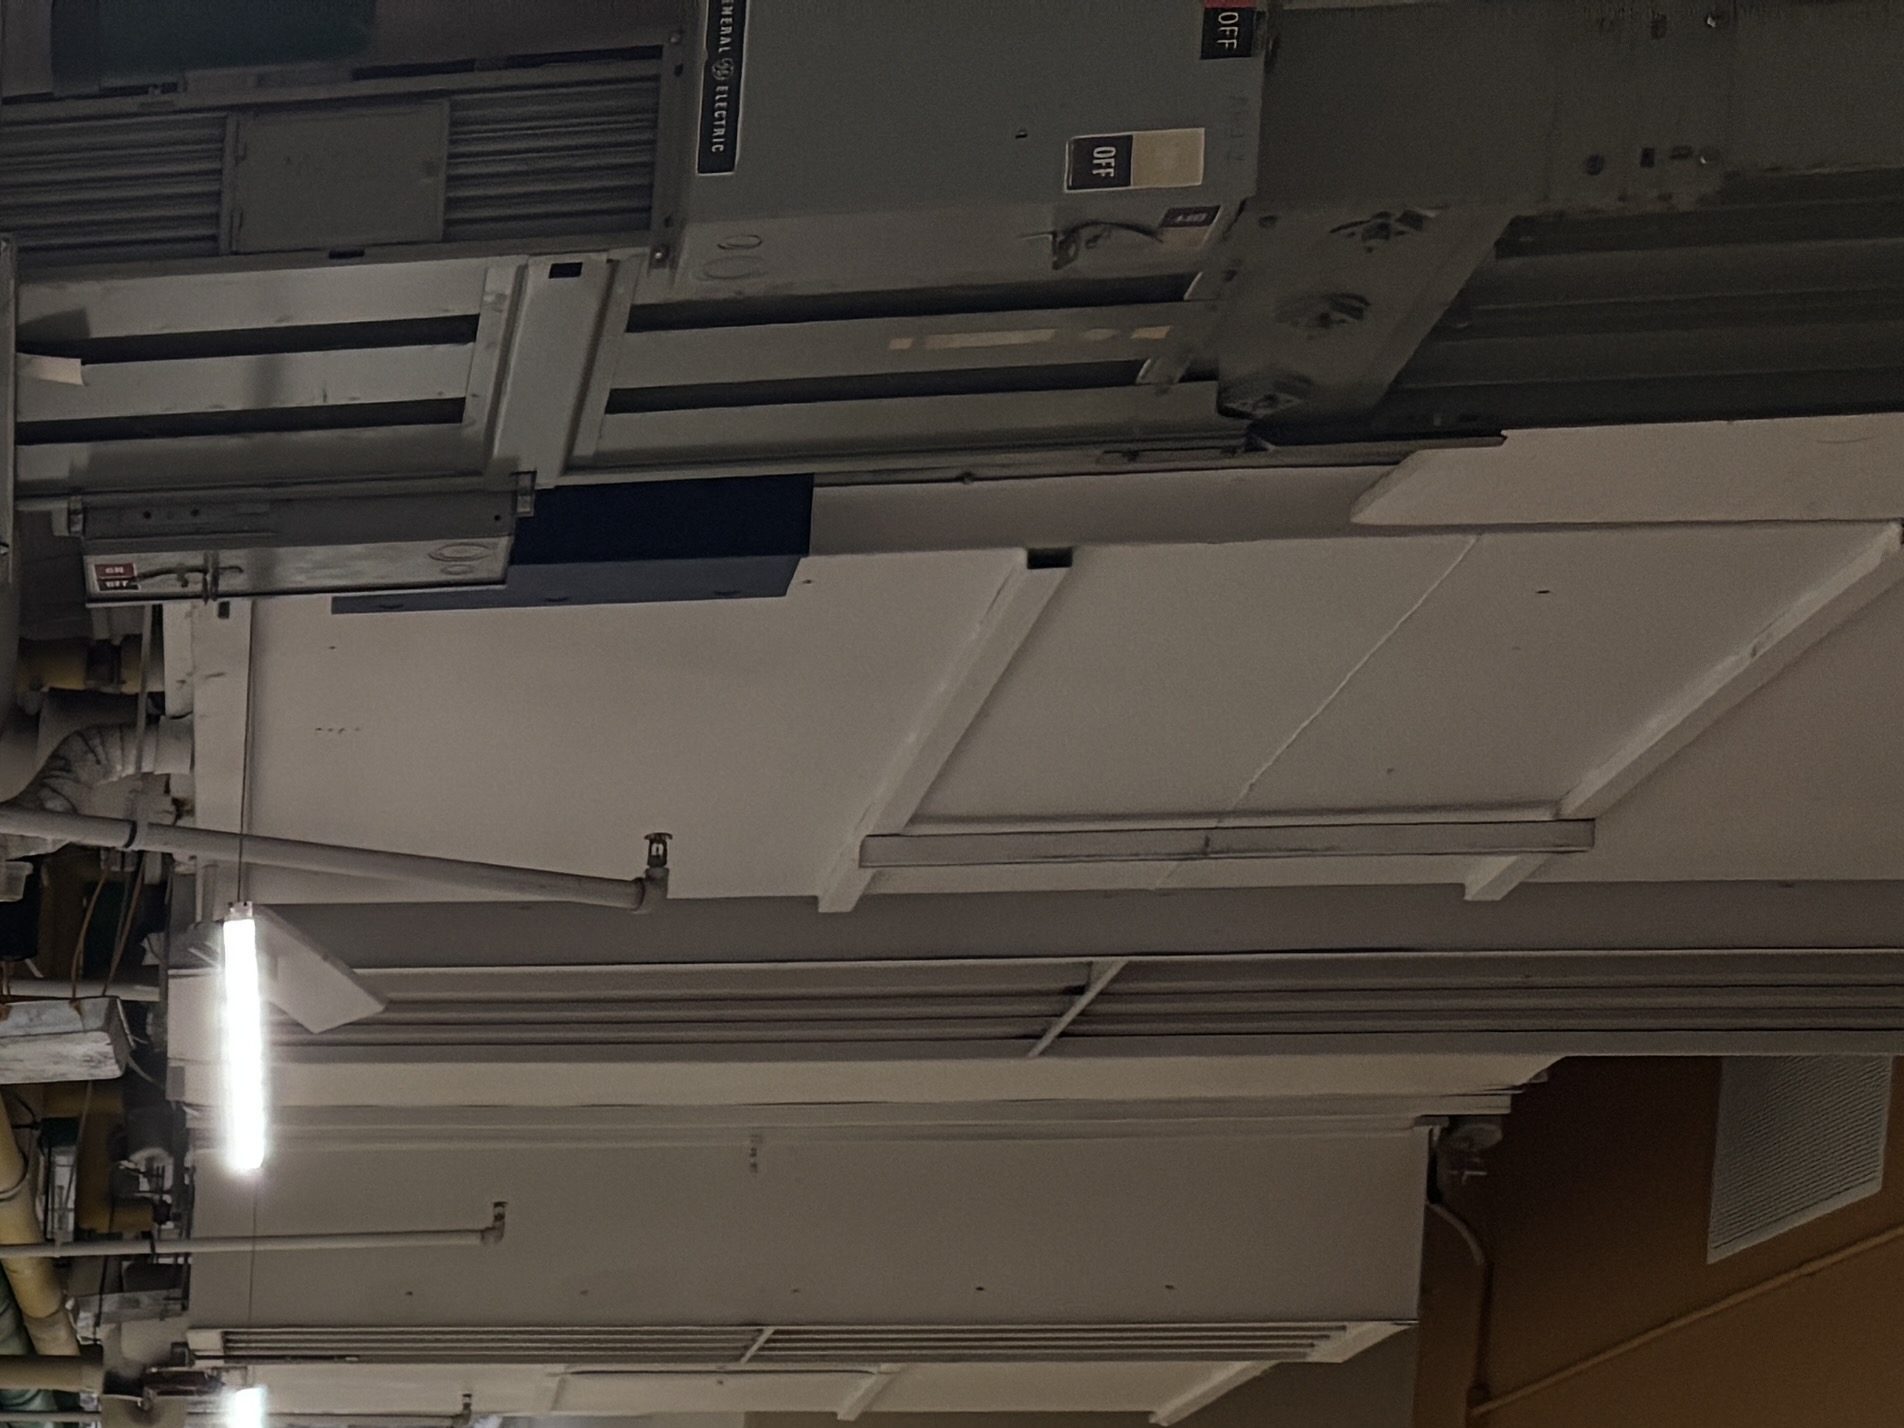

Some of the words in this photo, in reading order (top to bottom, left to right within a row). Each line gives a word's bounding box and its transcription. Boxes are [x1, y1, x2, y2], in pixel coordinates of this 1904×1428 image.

[1216, 11, 1240, 50] OFF
[711, 85, 730, 153] ELECTRIC
[1091, 146, 1117, 178] OFF
